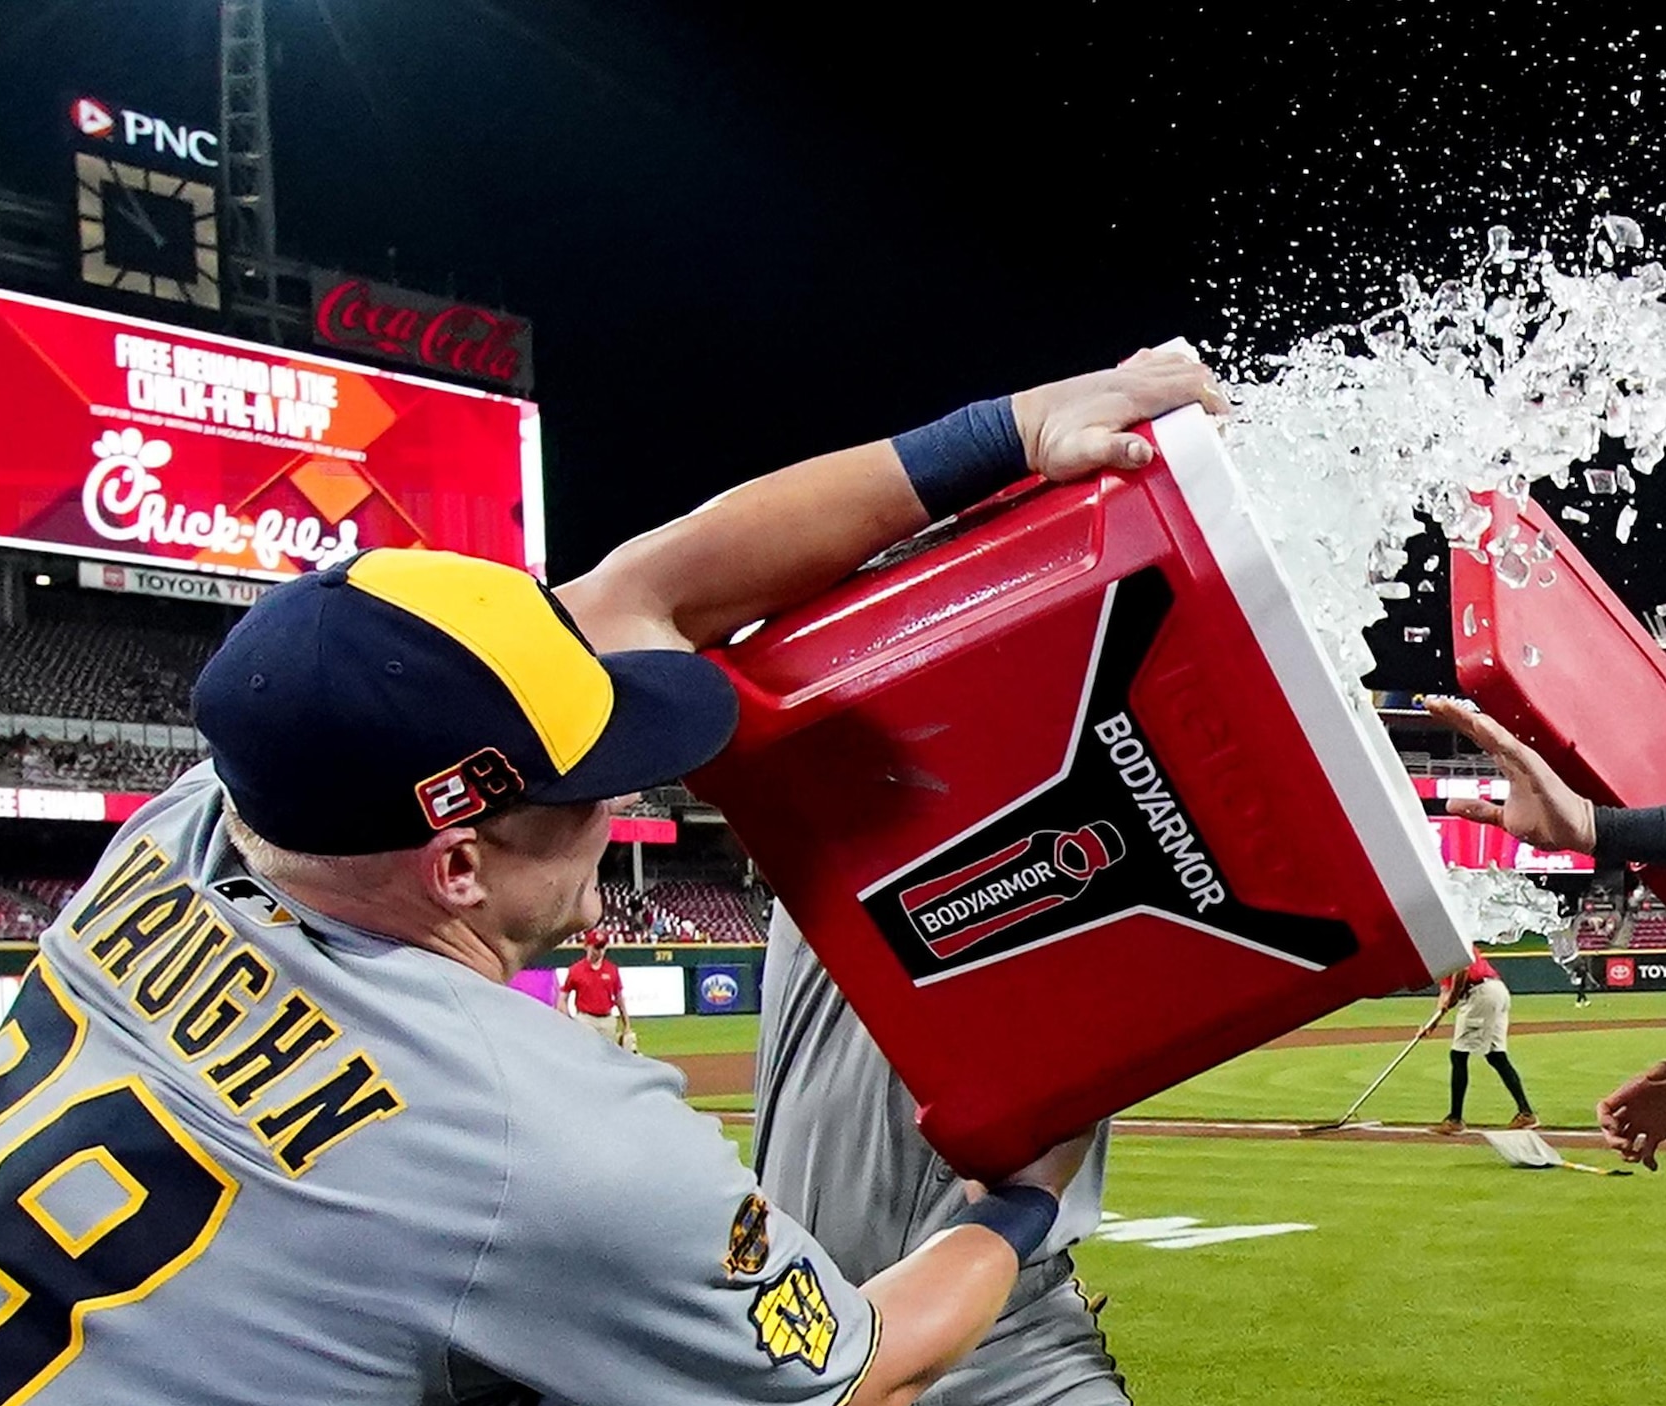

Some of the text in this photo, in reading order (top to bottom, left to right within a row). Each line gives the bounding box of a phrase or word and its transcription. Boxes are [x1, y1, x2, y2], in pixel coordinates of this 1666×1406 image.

[121, 109, 218, 166] PNC
[134, 572, 221, 597] TOYOTA
[1094, 712, 1225, 913] BODYARMOR
[920, 861, 1056, 933] BODYARMOR
[68, 834, 408, 1179] VAUGHN
